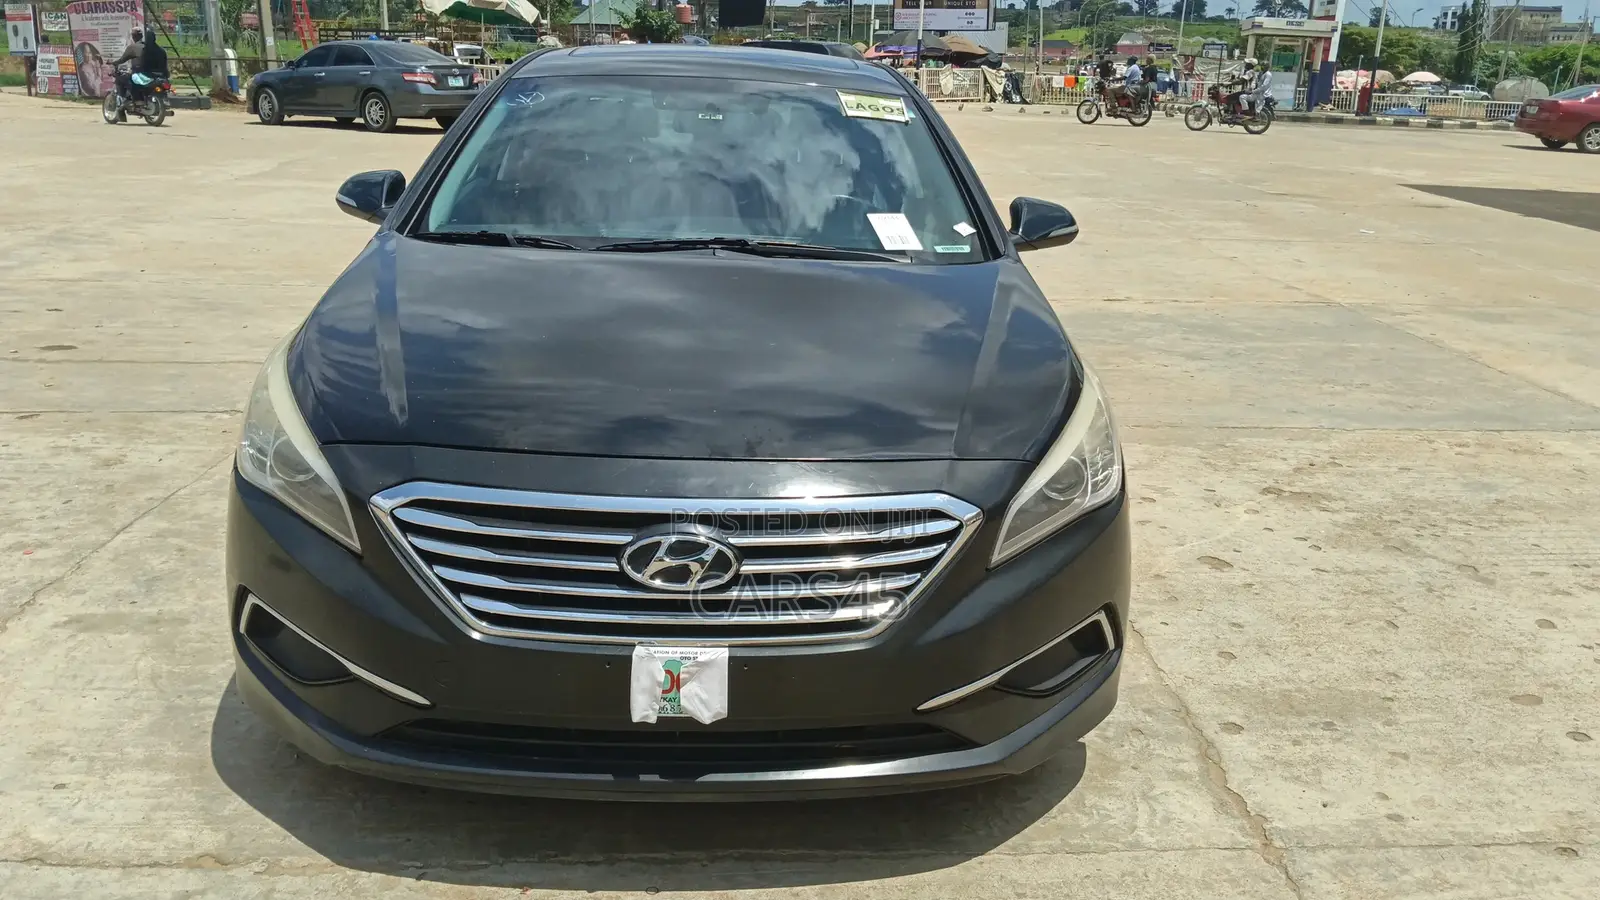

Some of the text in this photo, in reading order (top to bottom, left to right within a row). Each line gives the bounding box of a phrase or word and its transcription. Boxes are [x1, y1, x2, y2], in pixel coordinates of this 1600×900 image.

[73, 1, 139, 14] CLARASSPA
[44, 12, 67, 20] ICAN
[844, 101, 905, 117] LAGOS
